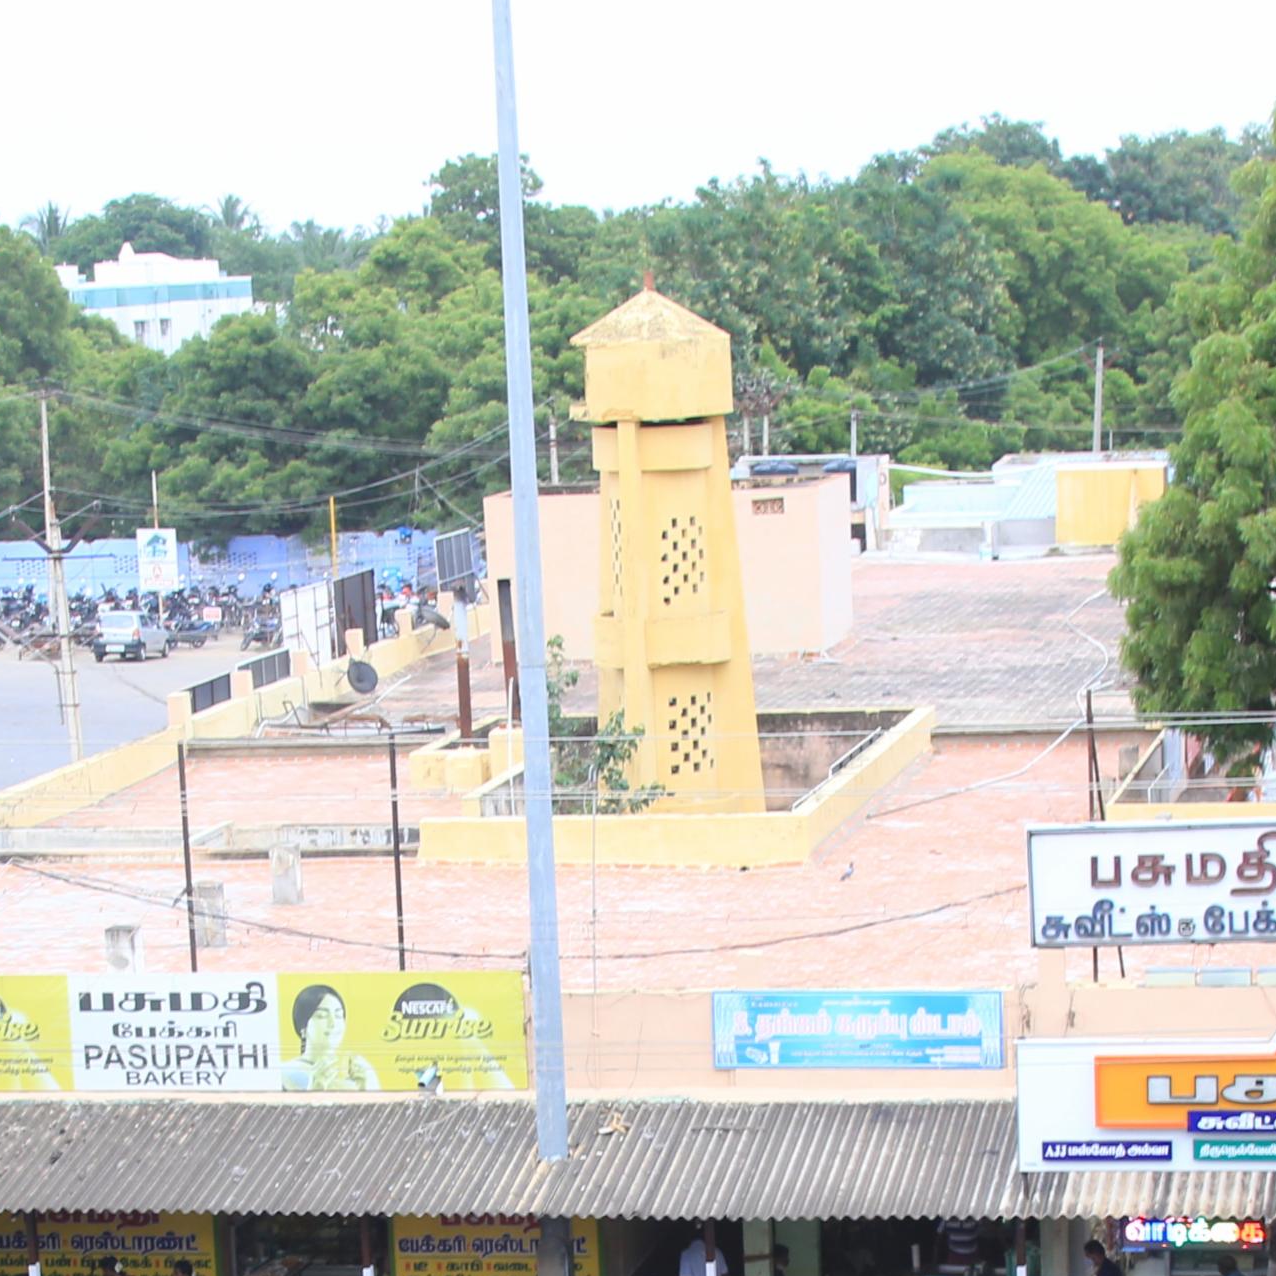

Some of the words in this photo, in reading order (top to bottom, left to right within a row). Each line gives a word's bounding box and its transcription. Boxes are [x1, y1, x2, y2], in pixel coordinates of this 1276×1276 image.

[1041, 898, 1171, 940] சுவீட்ஸ்
[78, 980, 269, 1019] பசுமதி
[401, 997, 454, 1015] NESCAFÉ
[112, 1020, 238, 1039] பேக்கரி
[380, 1010, 494, 1043] Sunrise
[84, 1044, 269, 1070] PASUPATHI
[125, 1070, 227, 1086] BAKERY
